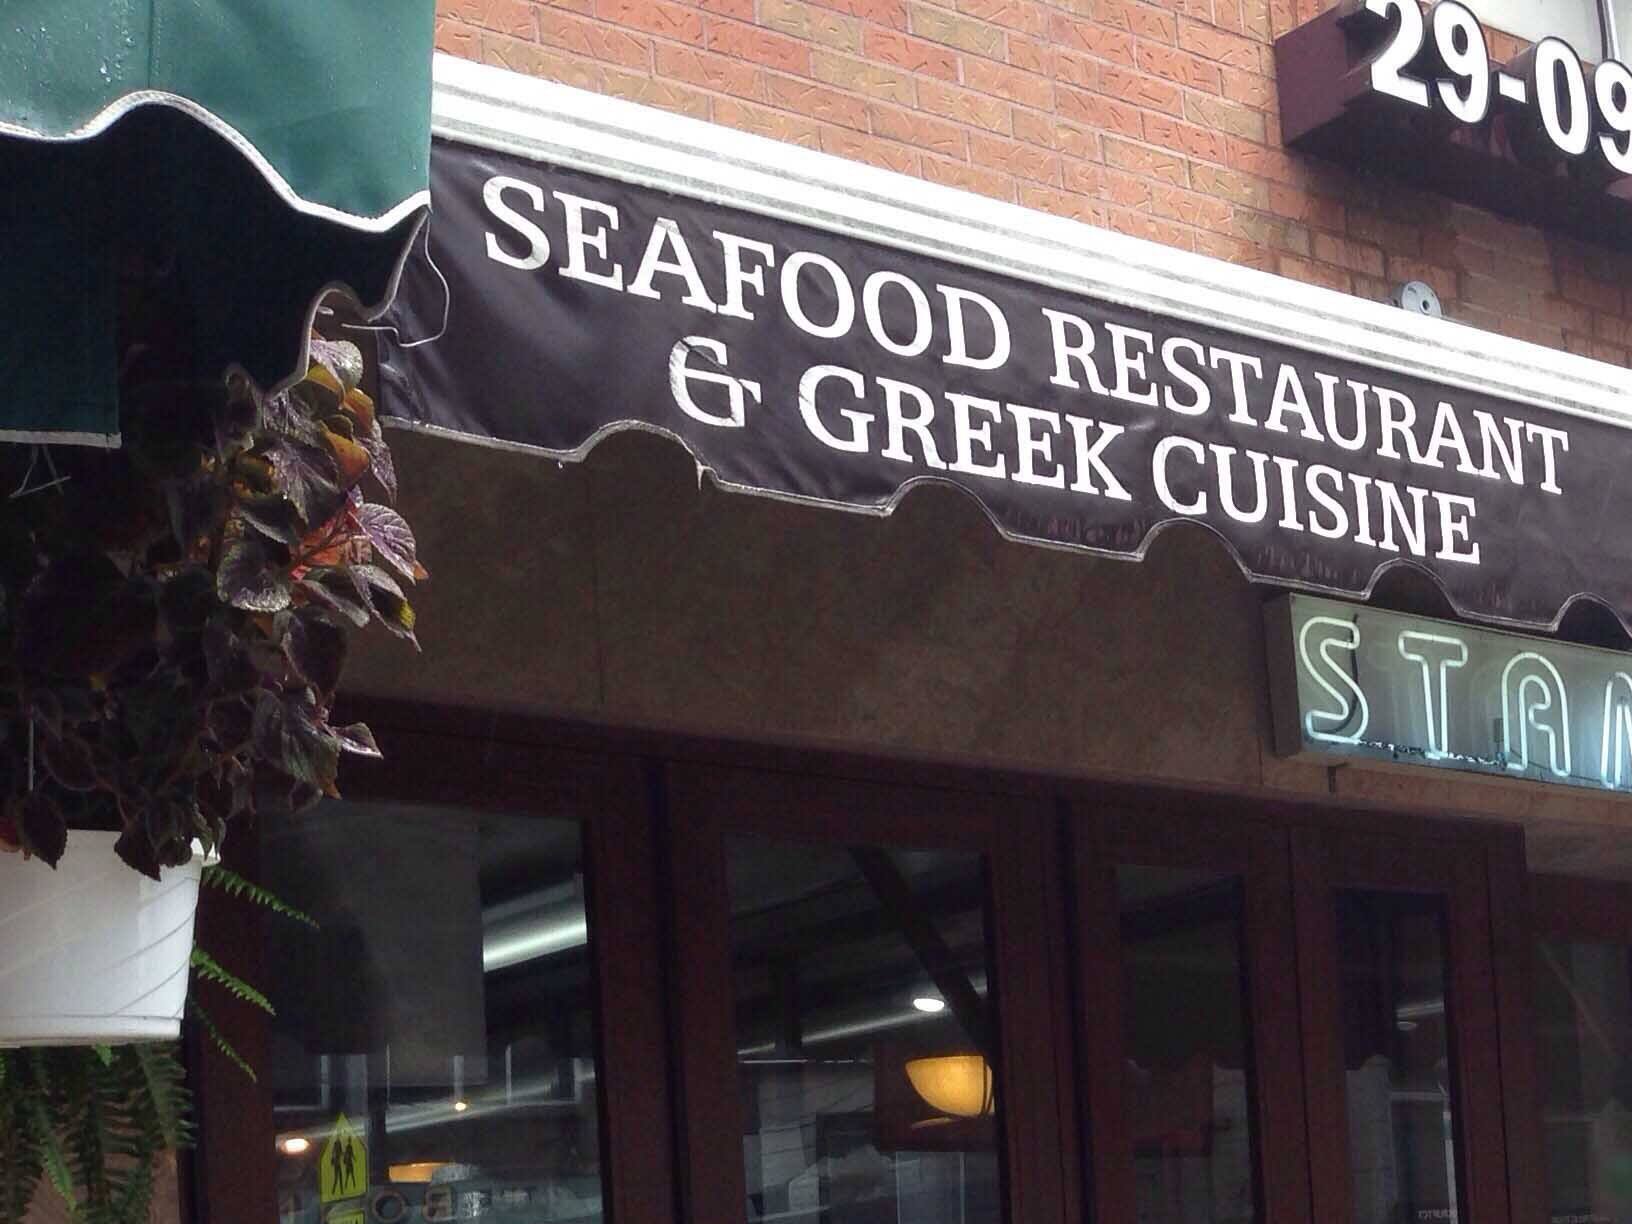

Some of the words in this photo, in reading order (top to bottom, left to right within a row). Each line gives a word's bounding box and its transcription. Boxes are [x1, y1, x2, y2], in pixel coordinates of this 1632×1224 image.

[481, 174, 1011, 371] SEAFOOD
[1041, 307, 1570, 496] RESTAURANT
[797, 364, 1133, 503] GREEK
[1151, 435, 1482, 566] CUISINE
